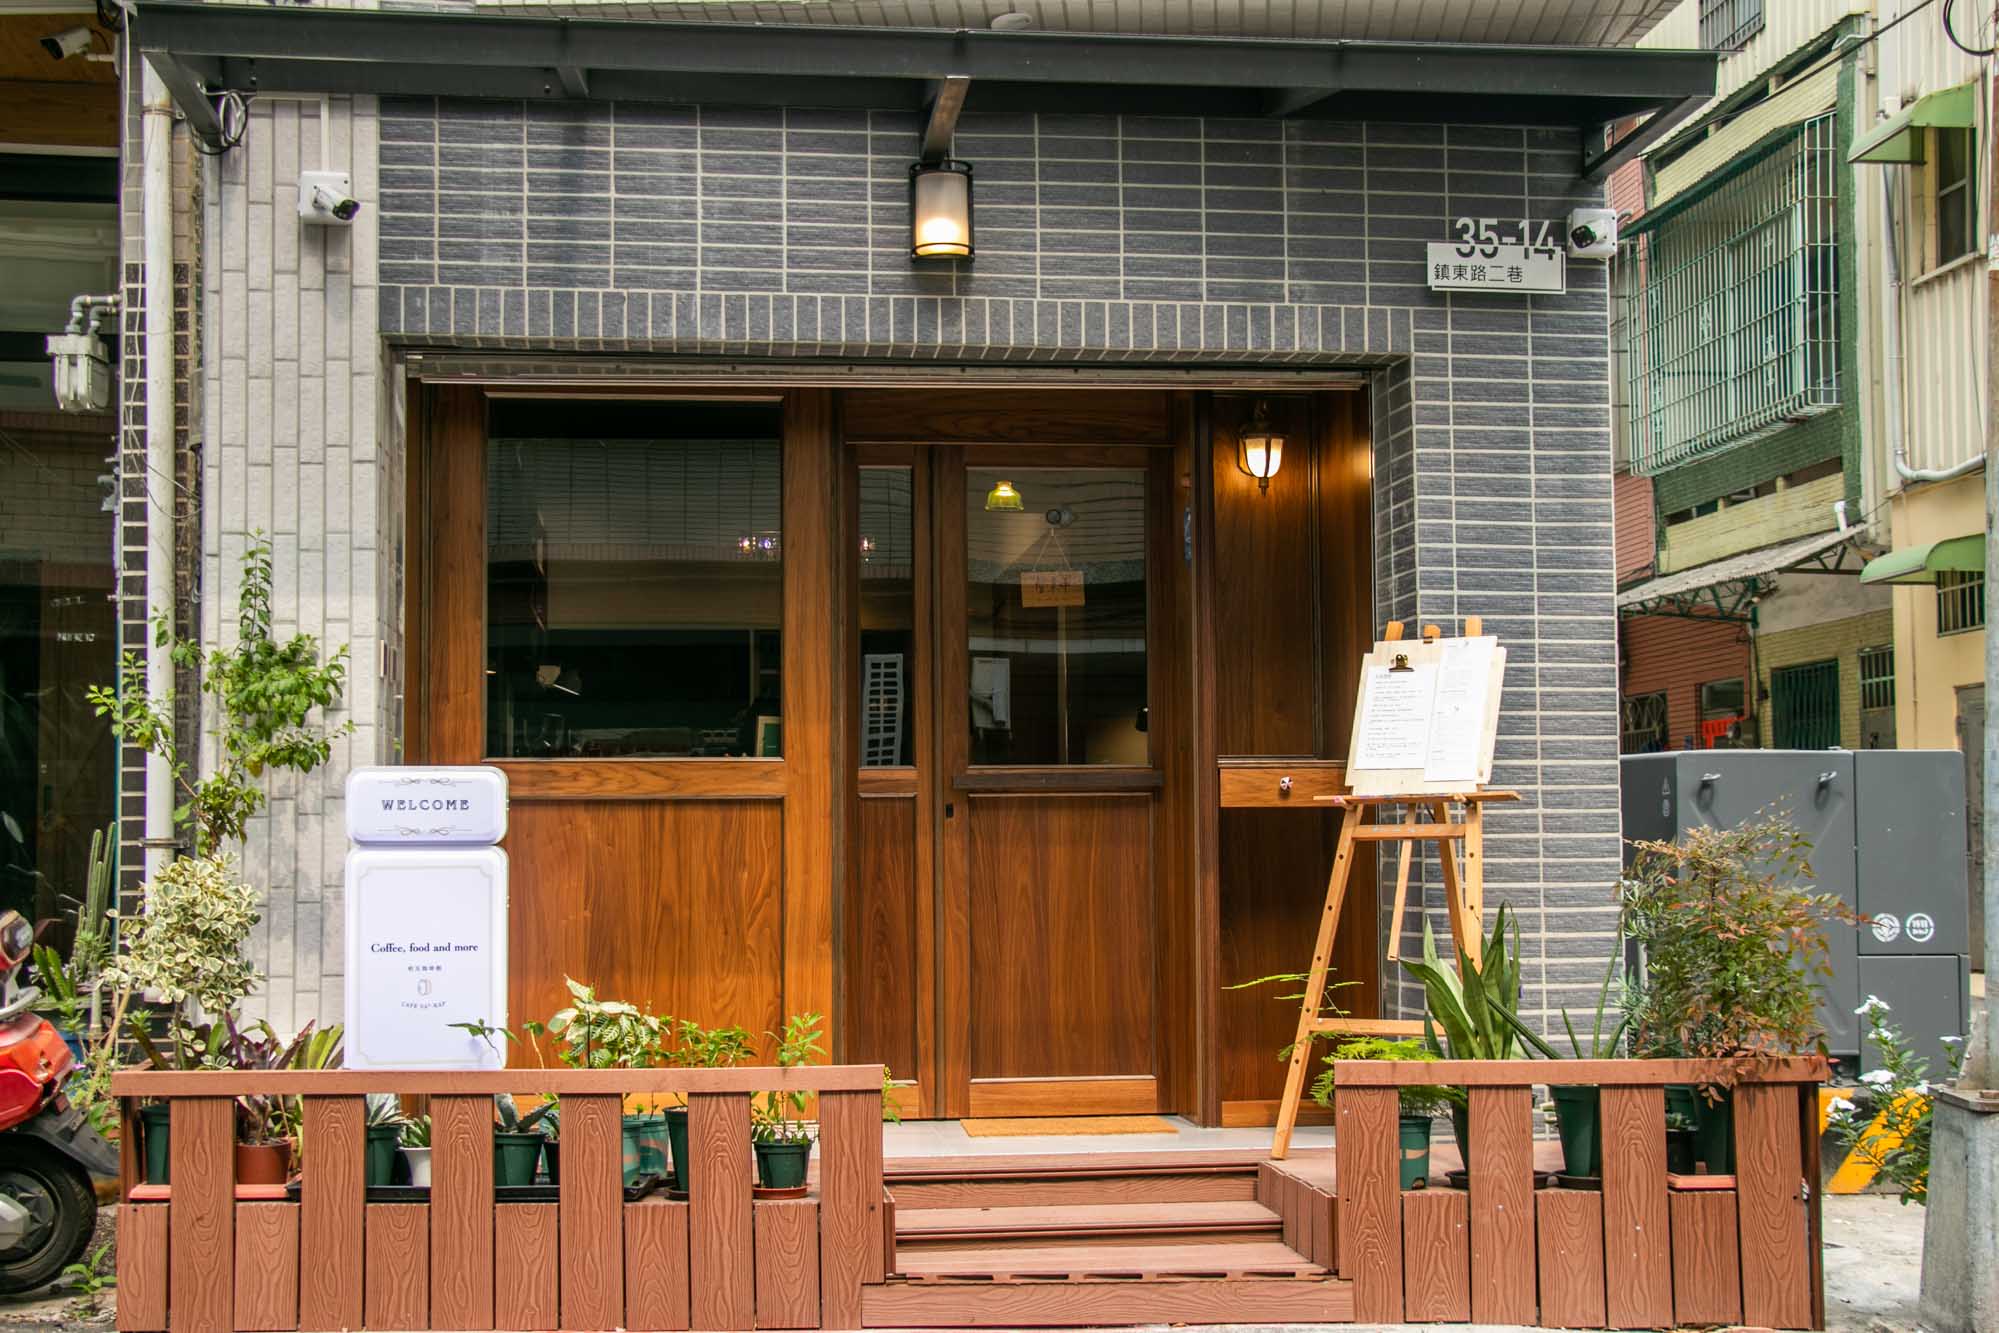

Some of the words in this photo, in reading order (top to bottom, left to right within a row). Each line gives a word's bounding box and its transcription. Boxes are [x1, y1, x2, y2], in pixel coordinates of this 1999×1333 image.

[1456, 217, 1556, 260] 35-14
[1434, 263, 1523, 283] 鎮東路二巷
[381, 799, 470, 811] WELCOME
[371, 943, 406, 953] Coffee,
[409, 942, 430, 952] food
[433, 942, 451, 952] and
[454, 944, 479, 952] more
